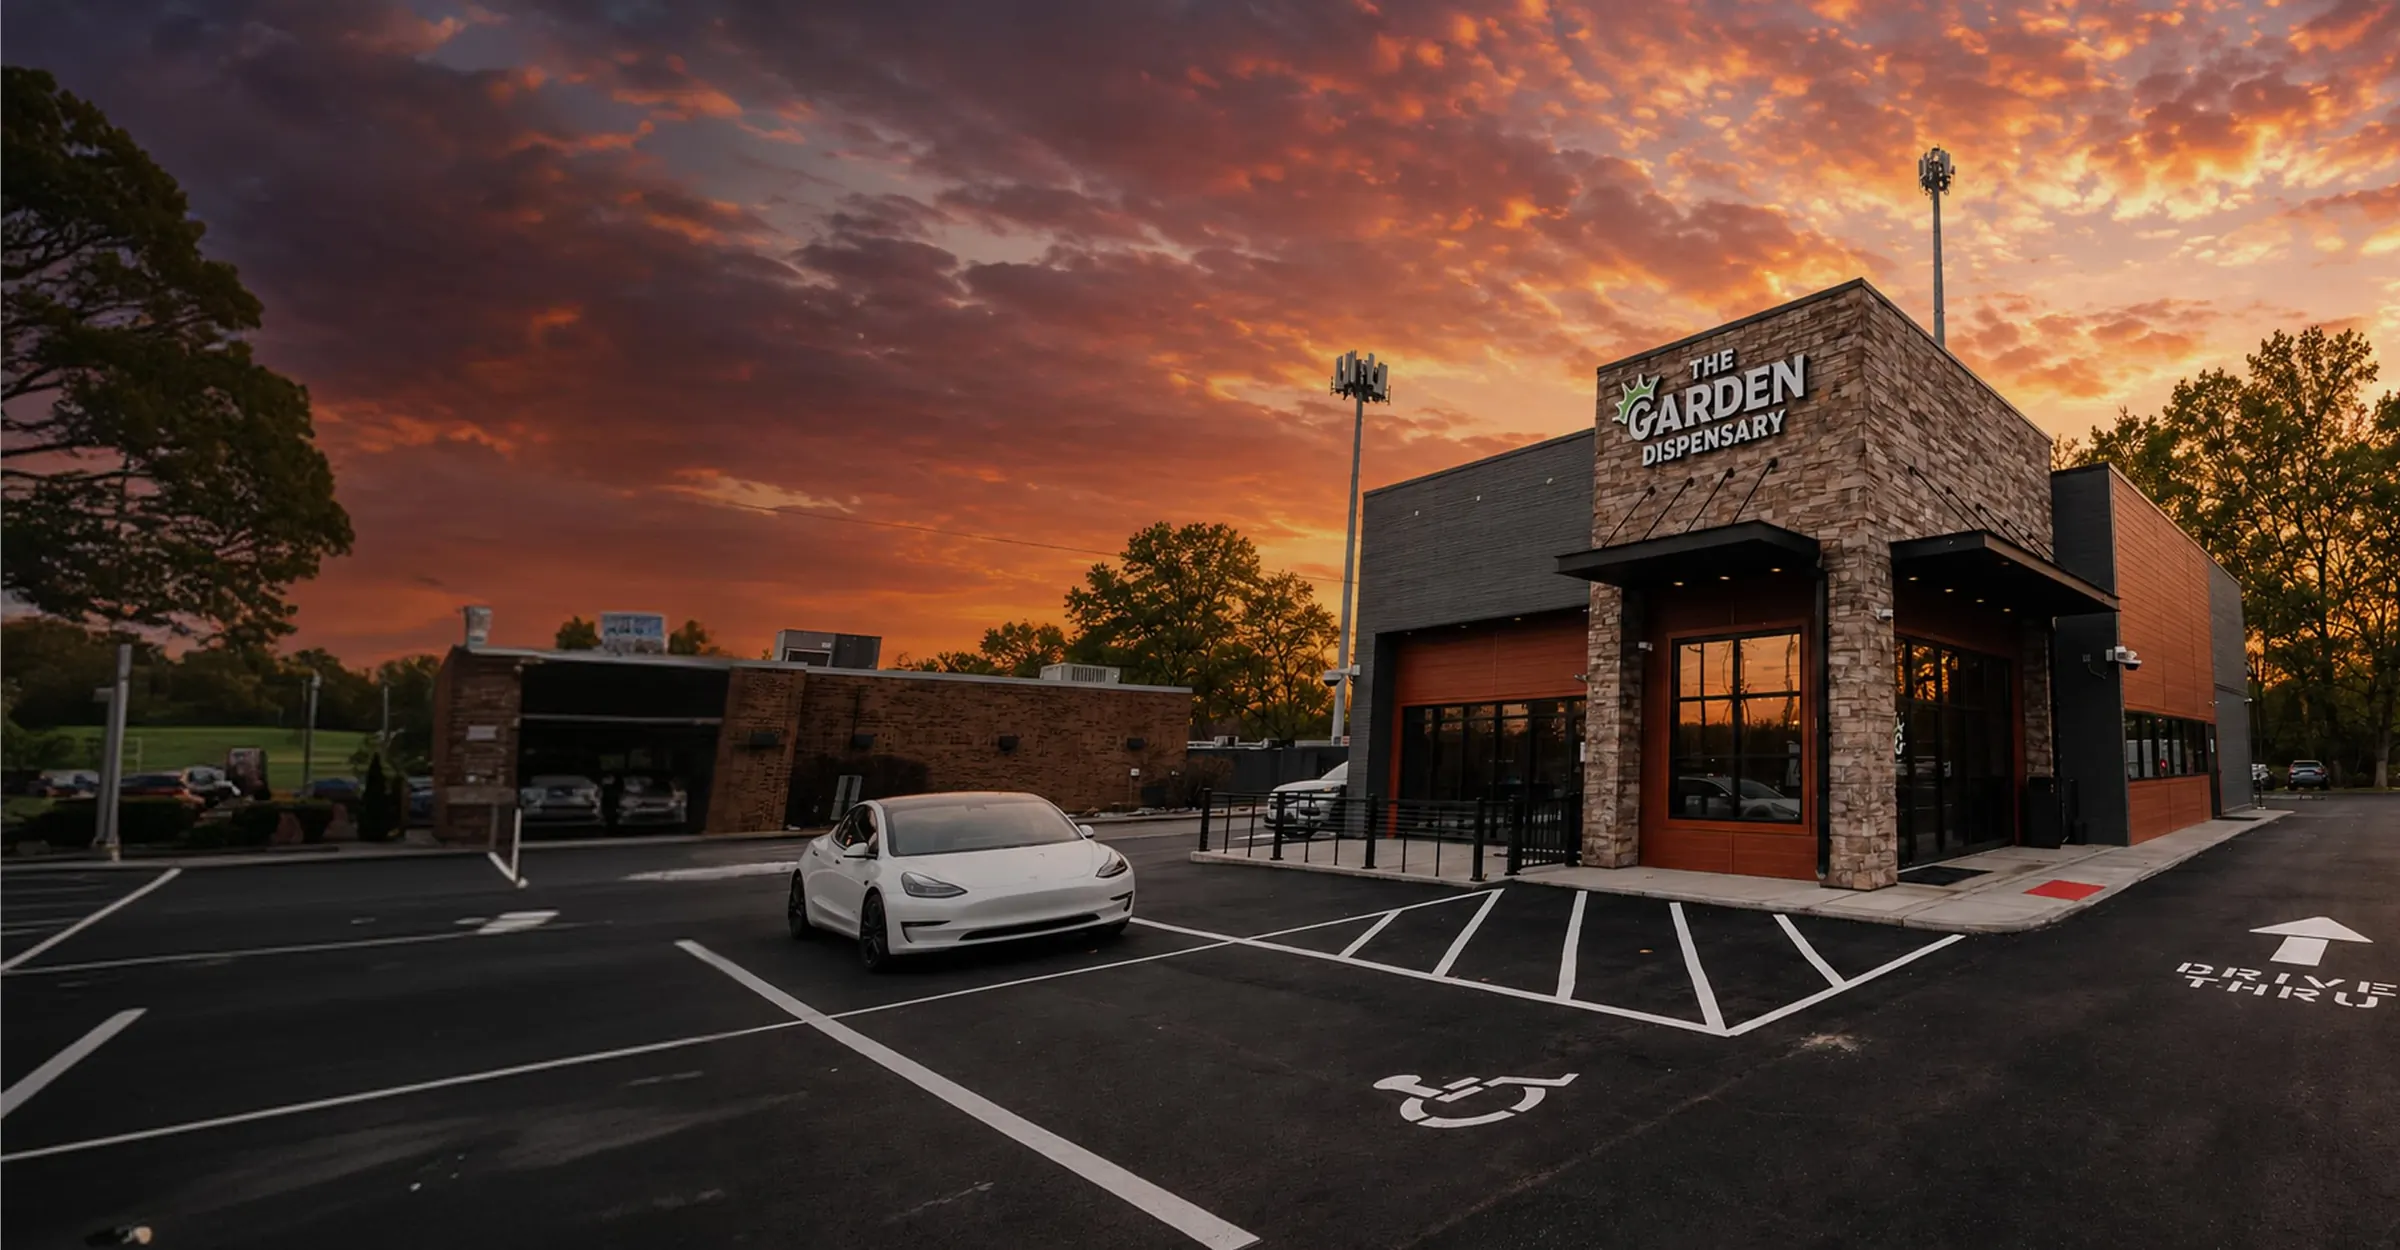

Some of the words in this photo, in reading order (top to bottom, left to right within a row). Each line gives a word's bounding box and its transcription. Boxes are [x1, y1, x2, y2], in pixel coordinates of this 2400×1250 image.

[1689, 347, 1735, 380] THE
[1628, 353, 1806, 442] GARDEN
[1641, 408, 1787, 467] DISPENSARY
[2176, 962, 2398, 997] DRIVE
[2184, 974, 2379, 1009] THRU
